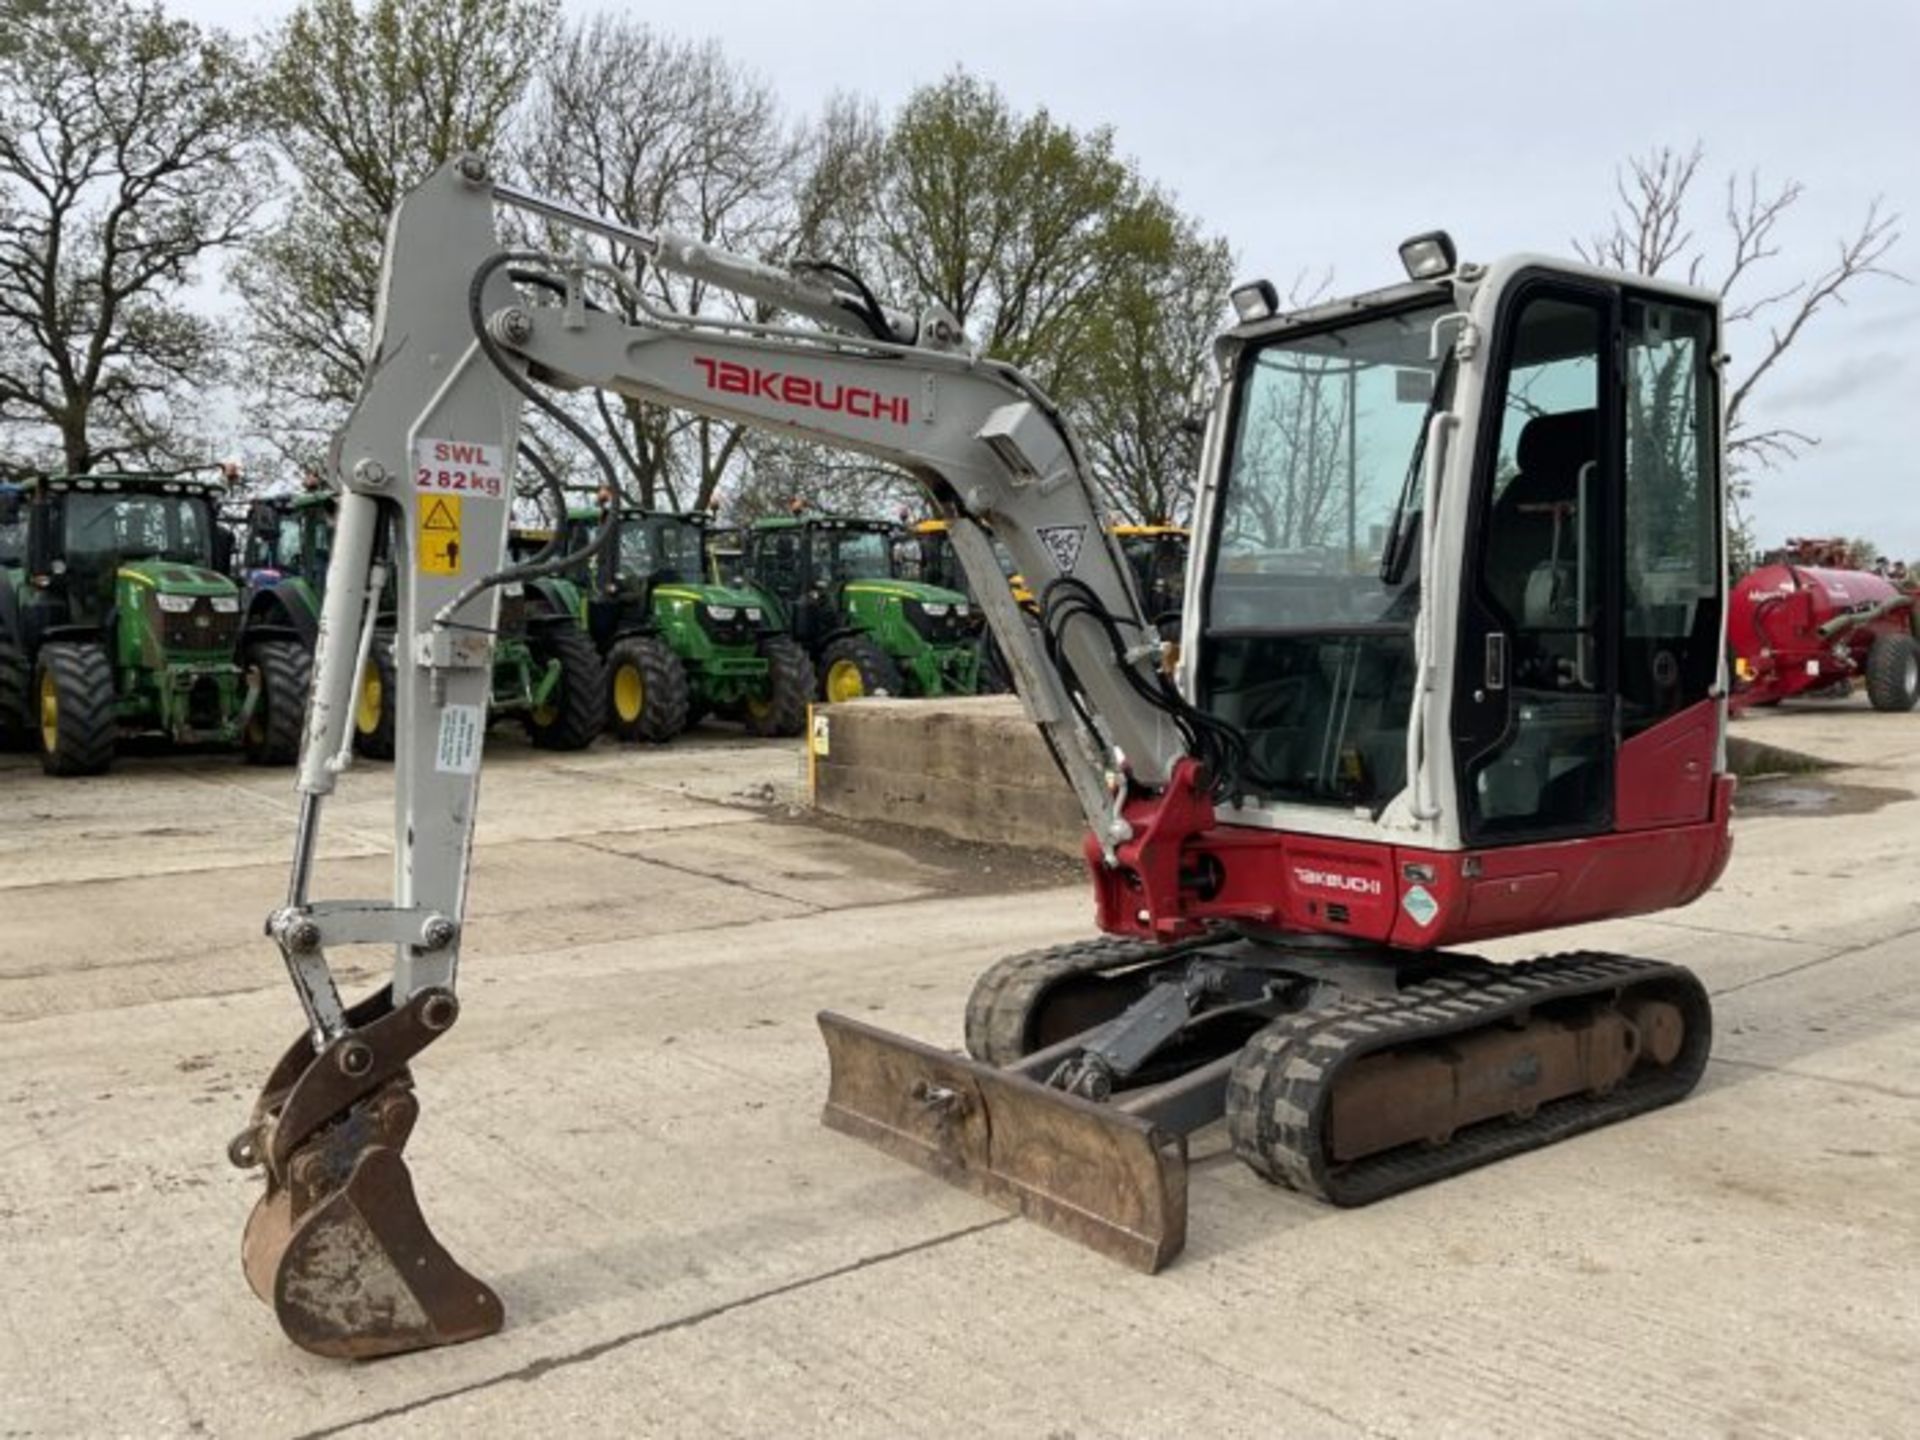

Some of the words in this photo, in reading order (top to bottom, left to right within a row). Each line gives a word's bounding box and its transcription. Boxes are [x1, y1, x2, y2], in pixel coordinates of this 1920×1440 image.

[694, 357, 909, 425] TAKEUCHI
[435, 443, 490, 466] SWL
[1294, 868, 1380, 894] TAKEUCHI
